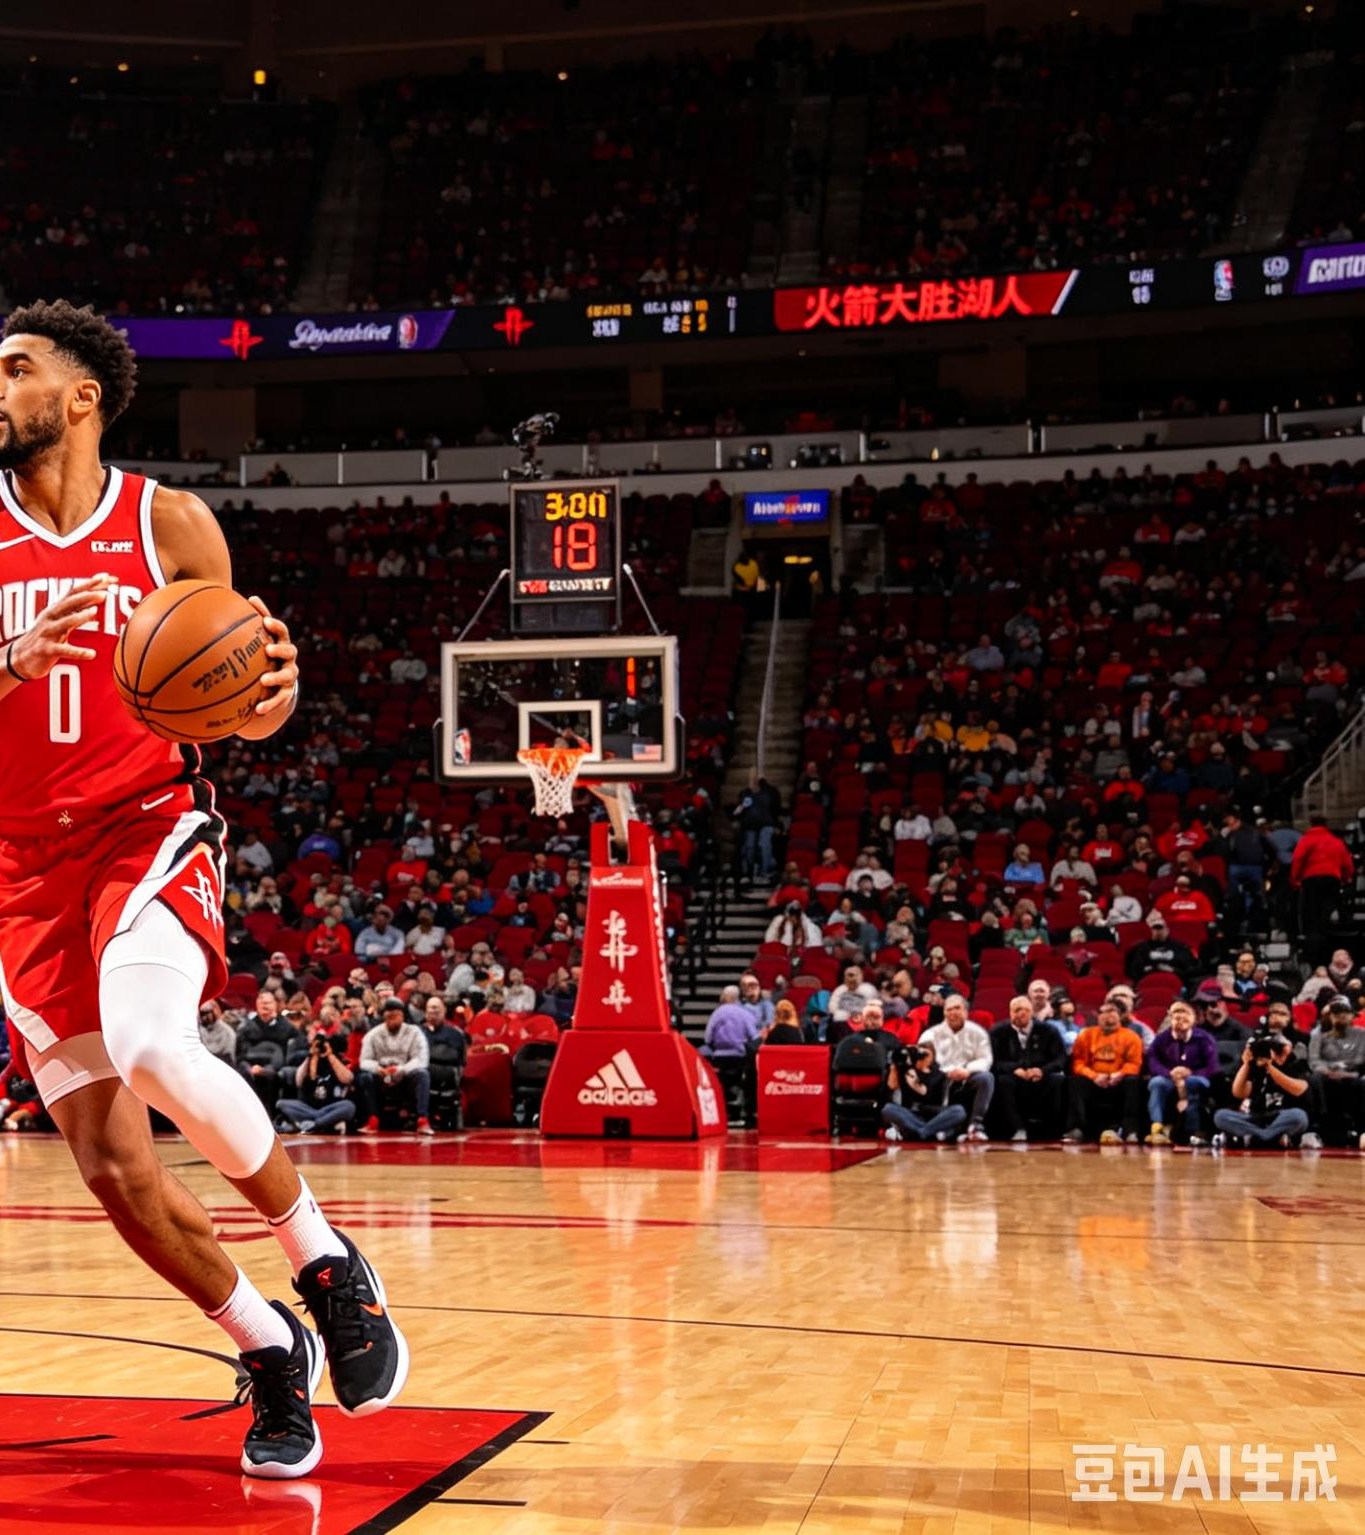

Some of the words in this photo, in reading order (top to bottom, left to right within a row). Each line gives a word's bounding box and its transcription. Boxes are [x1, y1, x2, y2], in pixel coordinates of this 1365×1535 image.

[803, 275, 1033, 329] 火箭大胜湖人
[553, 521, 597, 571] 18
[49, 665, 82, 744] 0
[577, 1088, 658, 1106] adidas
